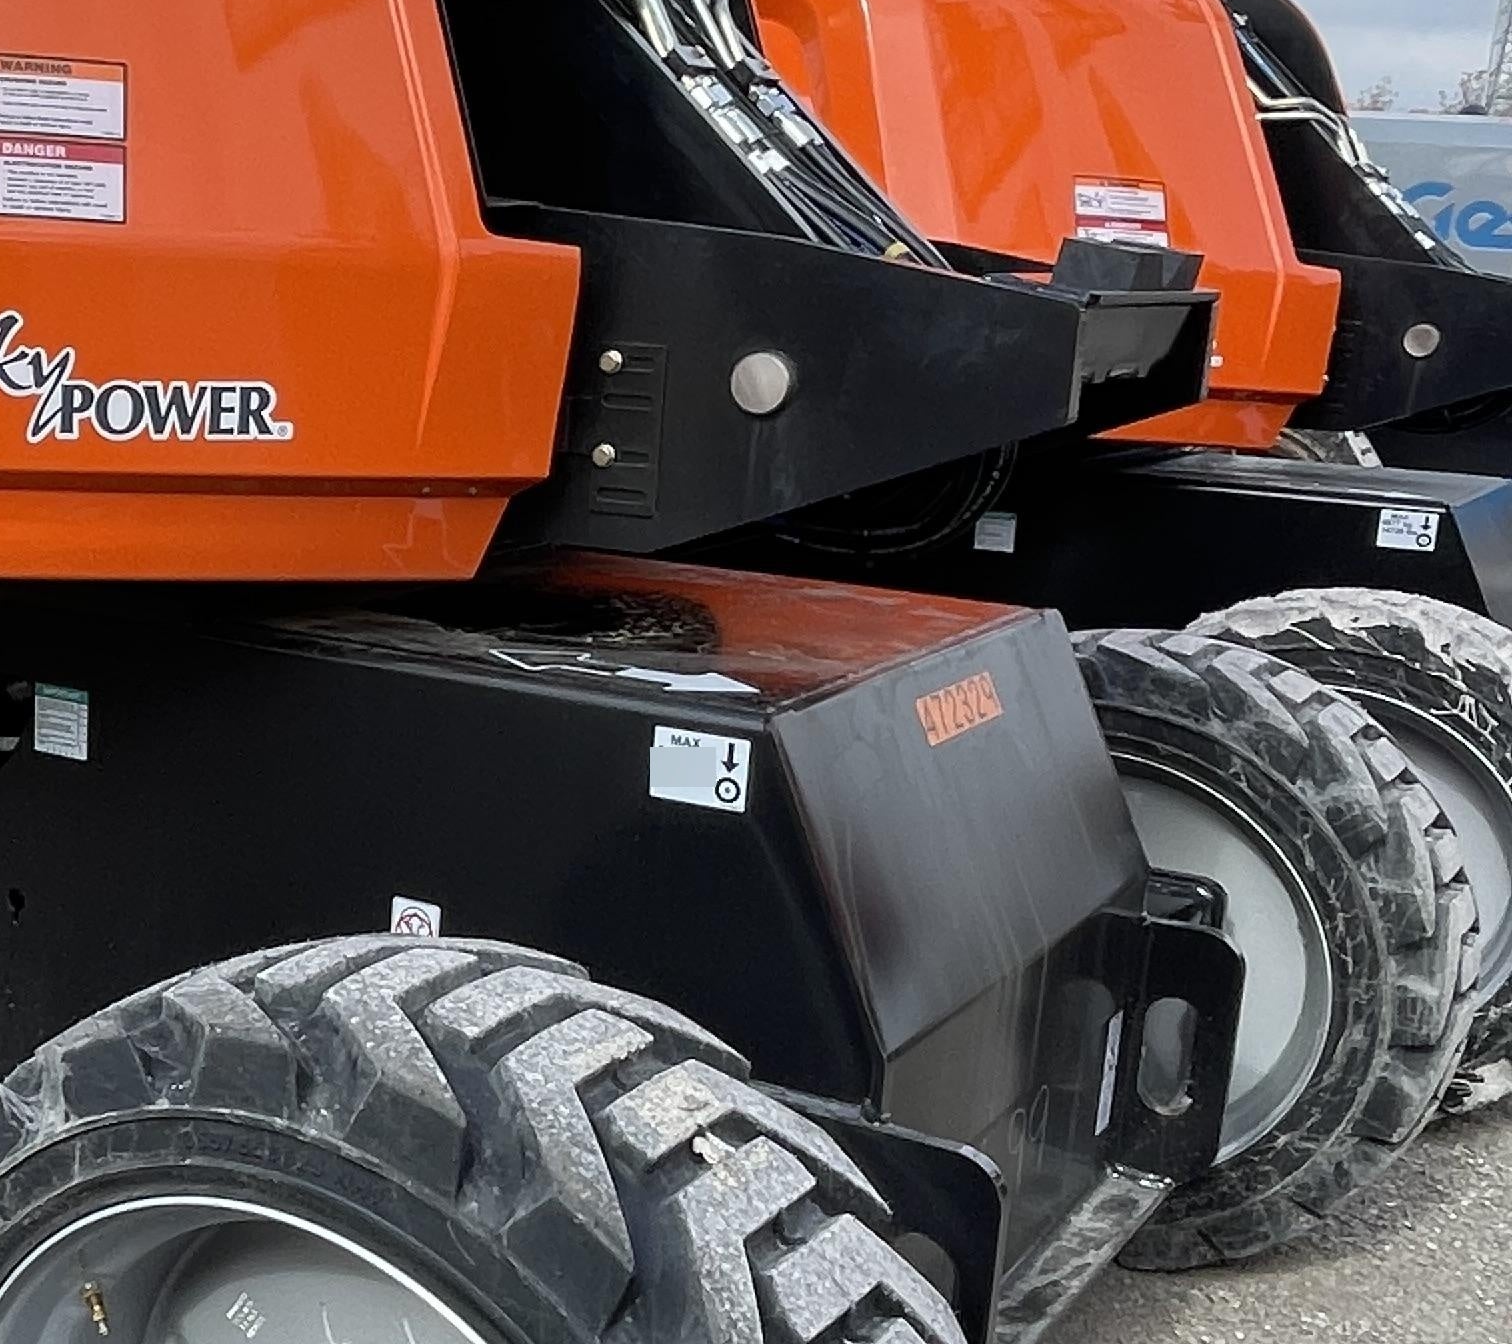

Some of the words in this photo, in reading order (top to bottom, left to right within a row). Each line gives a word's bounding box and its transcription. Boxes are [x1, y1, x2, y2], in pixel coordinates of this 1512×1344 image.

[0, 60, 73, 75] WARNING
[1, 142, 67, 158] DANGER
[670, 733, 701, 748] MAX
